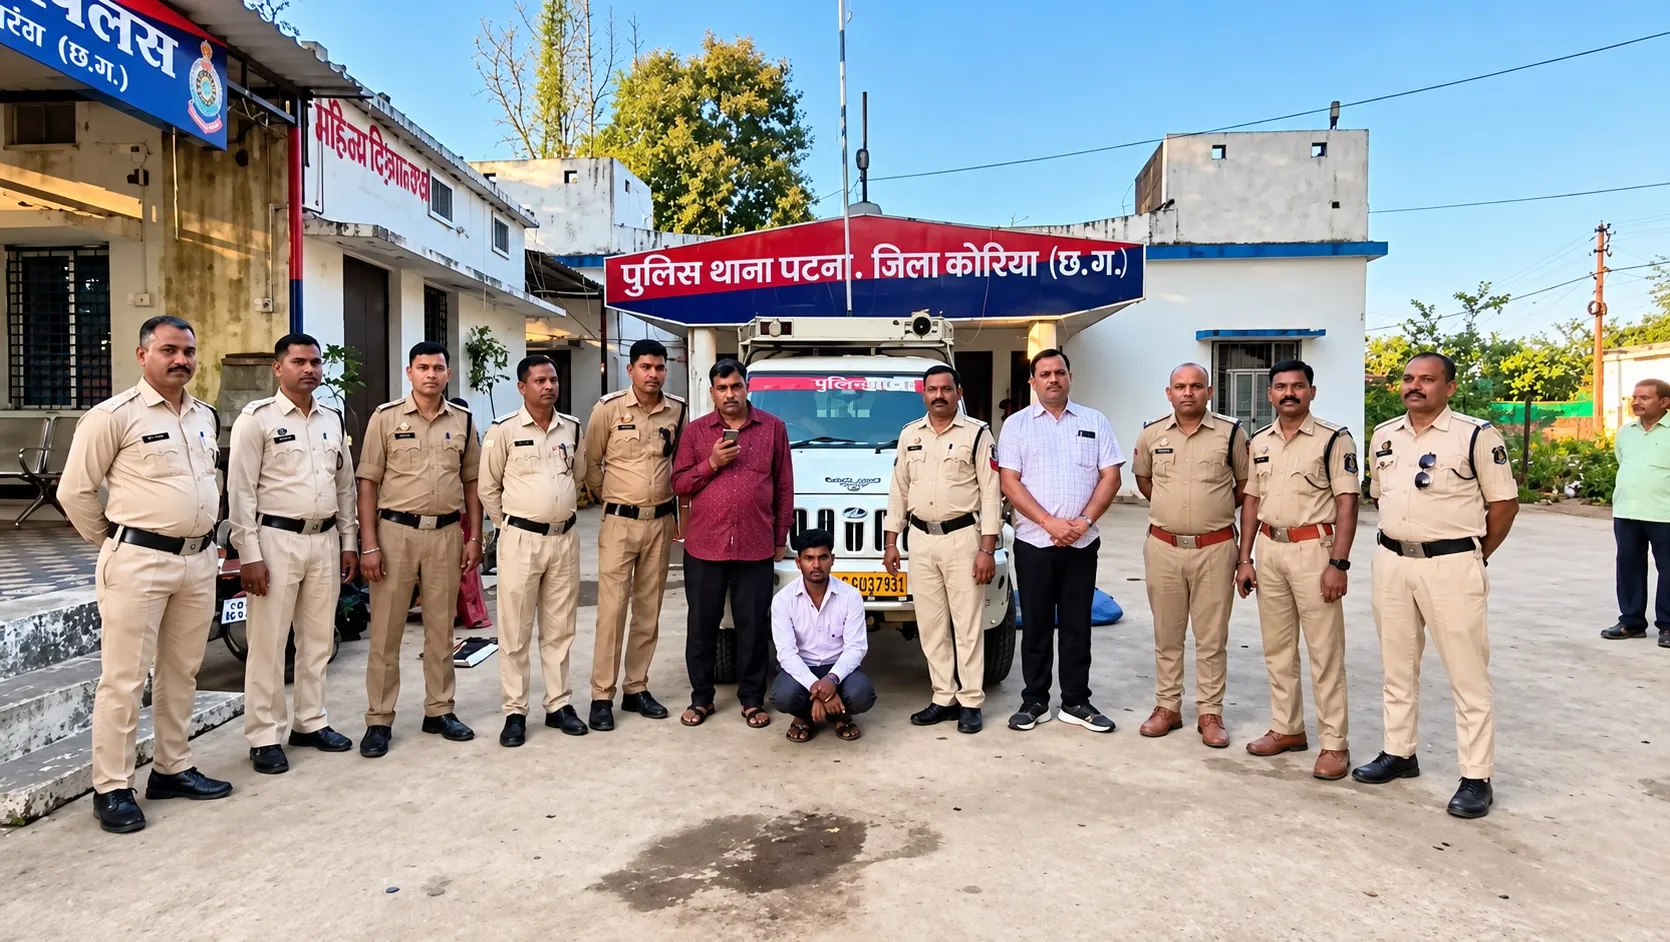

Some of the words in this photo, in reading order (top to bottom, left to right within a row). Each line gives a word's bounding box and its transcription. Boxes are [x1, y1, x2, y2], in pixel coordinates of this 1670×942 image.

[620, 254, 703, 297] पुलिस
[710, 258, 774, 285] थाना
[871, 243, 941, 279] जिला
[945, 242, 1040, 278] कोरिया
[1049, 245, 1128, 280] (छ.ग.)
